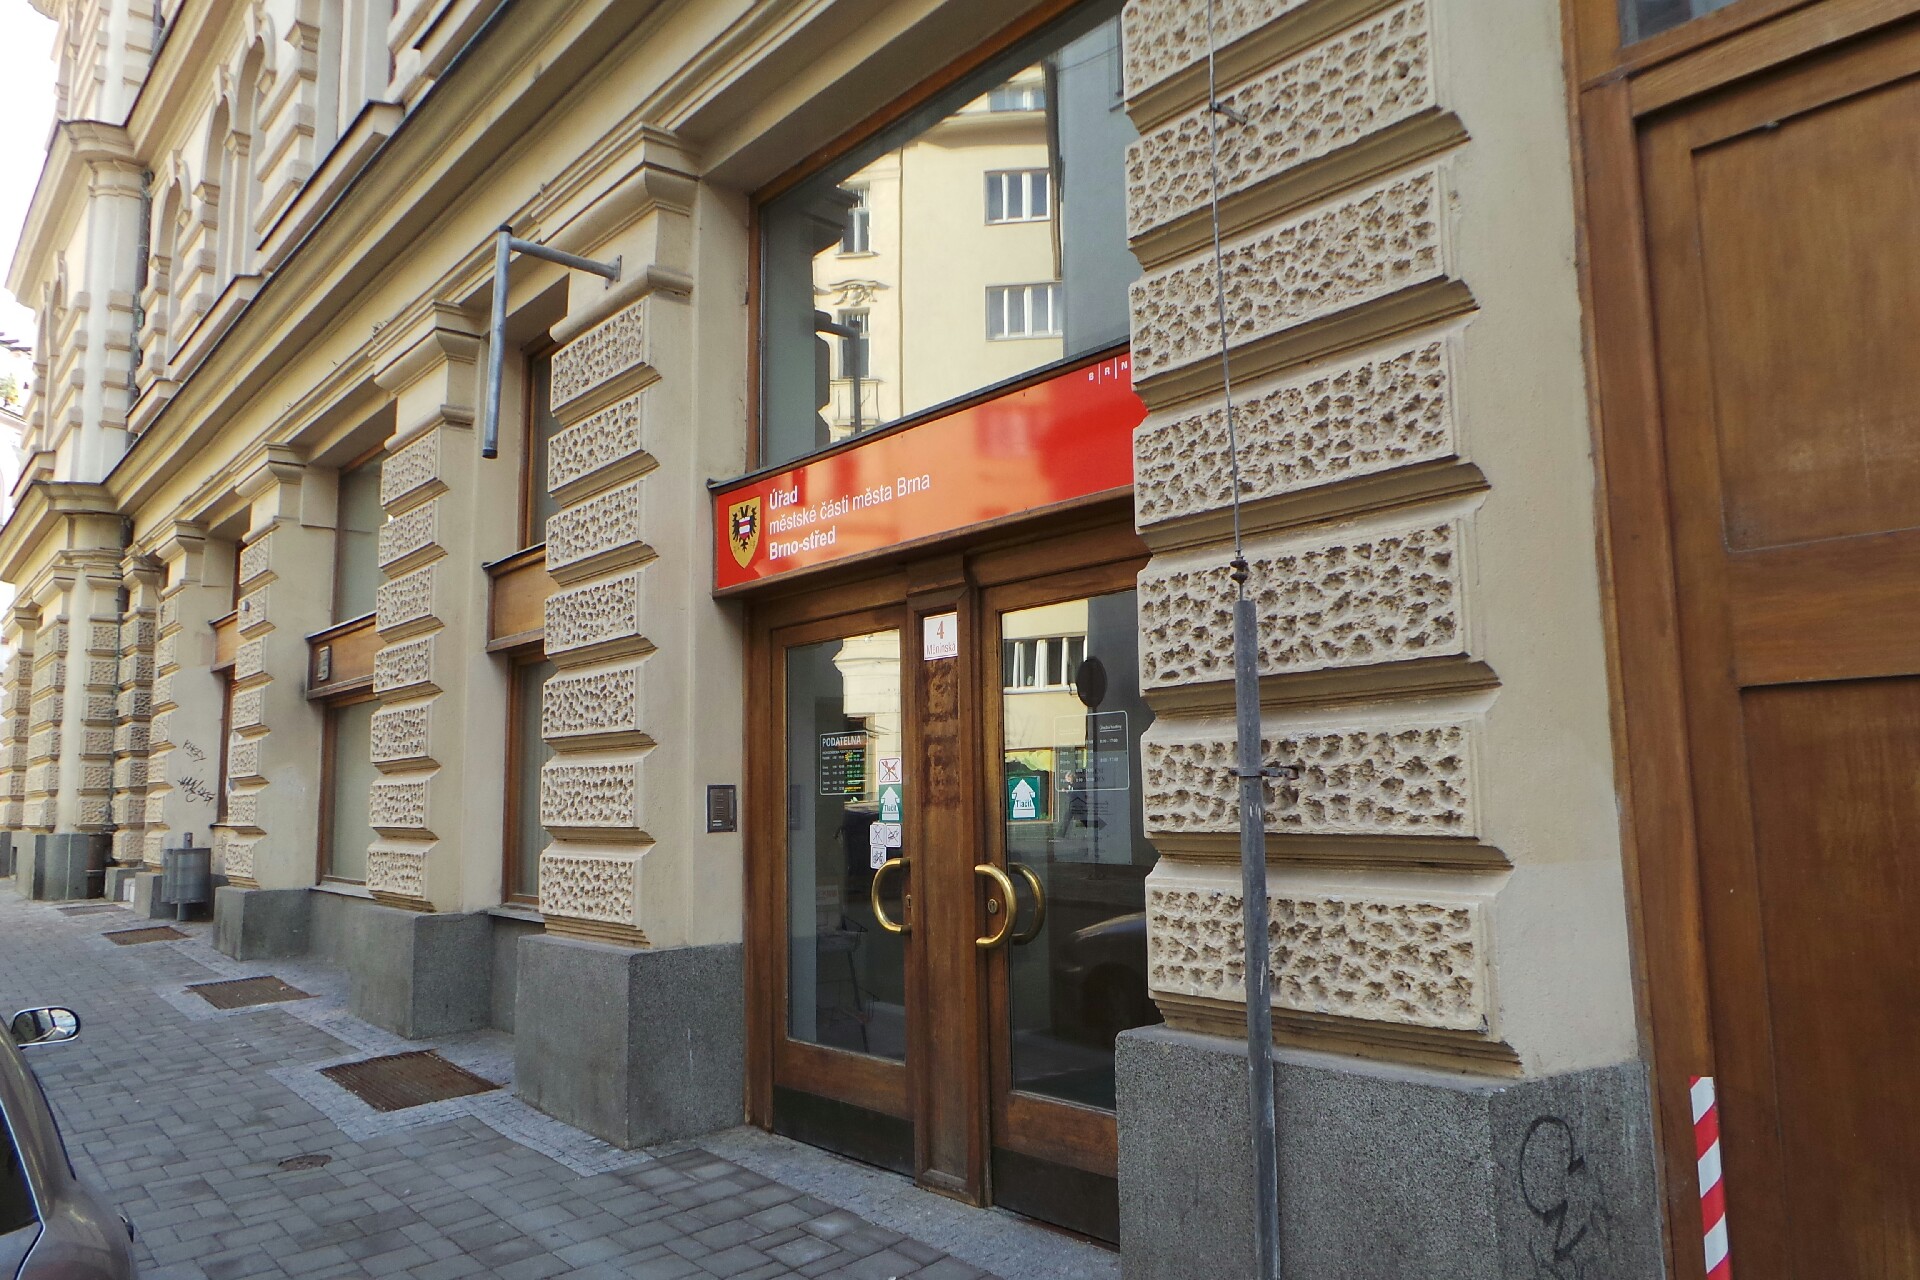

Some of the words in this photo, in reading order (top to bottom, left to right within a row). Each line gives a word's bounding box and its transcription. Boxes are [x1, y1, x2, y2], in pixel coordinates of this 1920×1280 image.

[769, 485, 798, 510] Úřad
[769, 505, 817, 535] městské
[820, 495, 849, 520] části
[852, 485, 892, 511] města
[897, 474, 930, 497] Brna
[769, 525, 836, 560] Brno-střed
[936, 620, 945, 639] 4
[822, 735, 862, 747] PODATELNA
